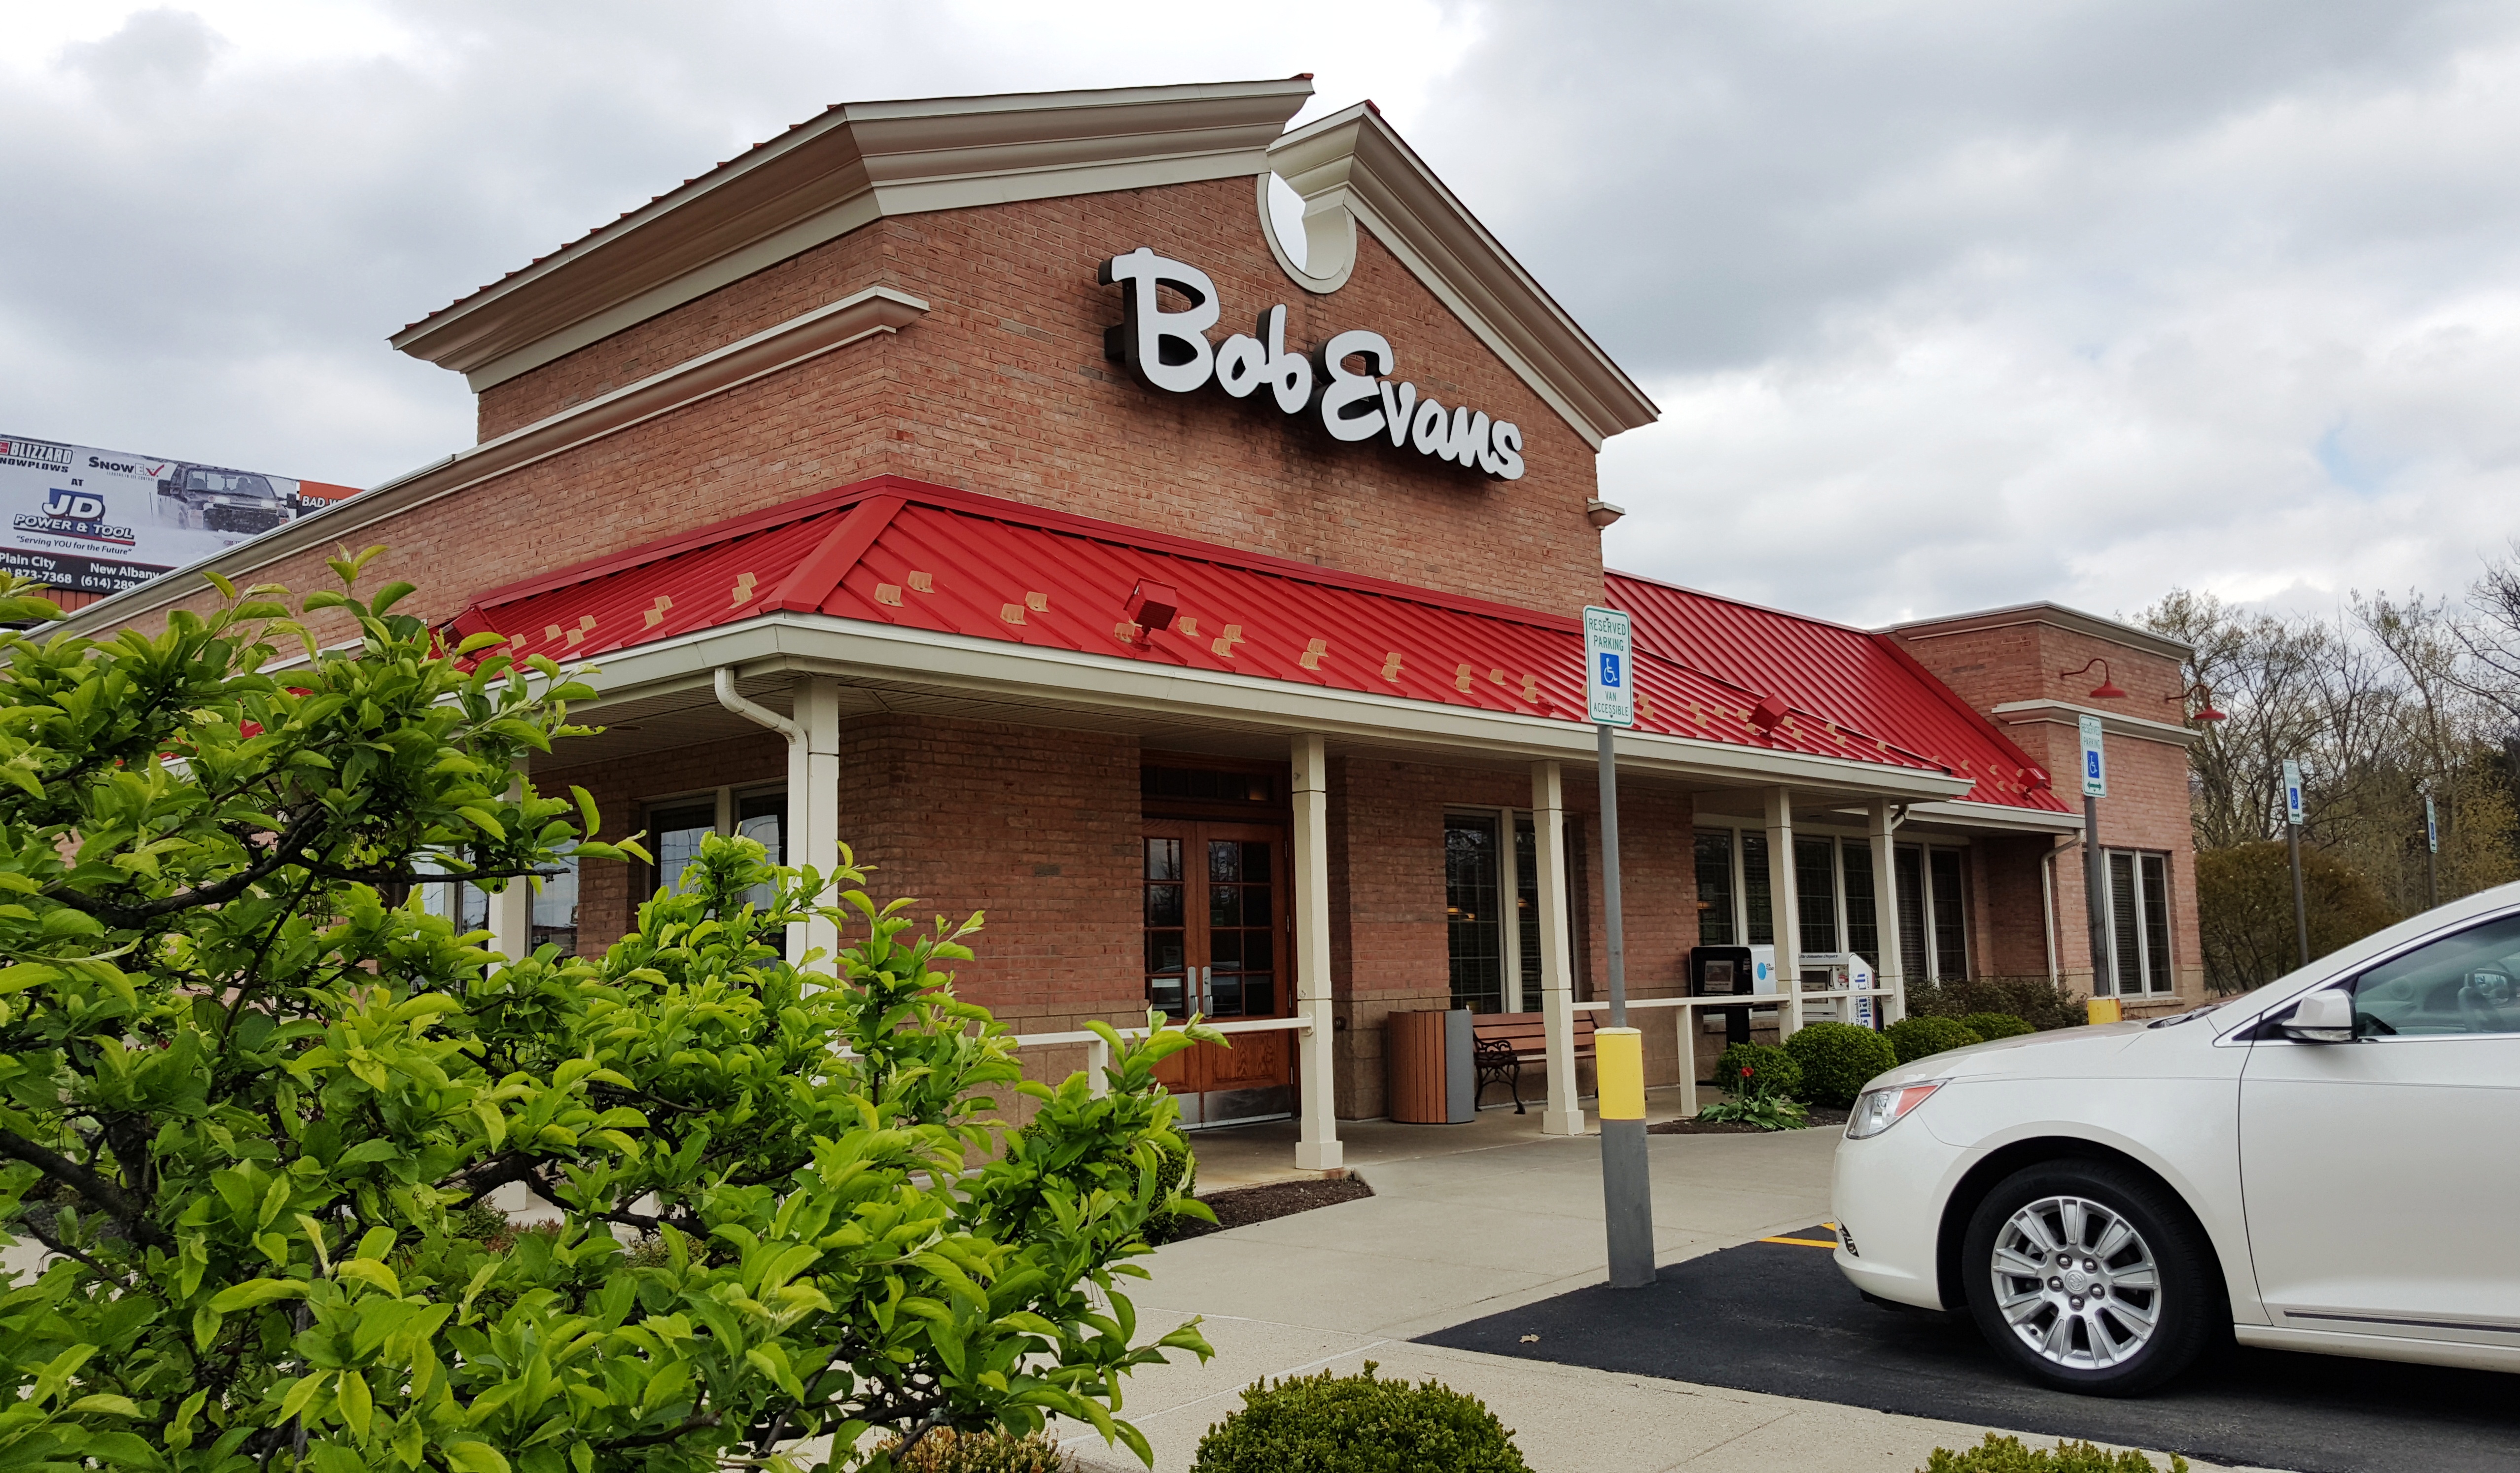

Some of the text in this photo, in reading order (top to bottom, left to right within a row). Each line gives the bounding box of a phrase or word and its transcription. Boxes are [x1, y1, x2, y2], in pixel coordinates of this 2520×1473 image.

[1111, 246, 1525, 481] Bob Evans
[10, 442, 72, 464] BLIZZARD
[0, 457, 69, 473] NOWPLOWS
[71, 478, 84, 487] AT
[301, 495, 326, 508] BAD
[14, 514, 135, 540] POWER & TOOL
[54, 539, 72, 548] YOU
[87, 544, 100, 552] the
[0, 552, 56, 570] Plain City
[14, 568, 72, 584] 873-7368
[90, 562, 160, 580] New Albany
[81, 575, 136, 590] (614) 289
[1588, 618, 1626, 636] RESERVED
[1593, 635, 1624, 652] PARKING
[1605, 691, 1617, 702] VAN
[1593, 702, 1629, 716] ACCESSIBLE
